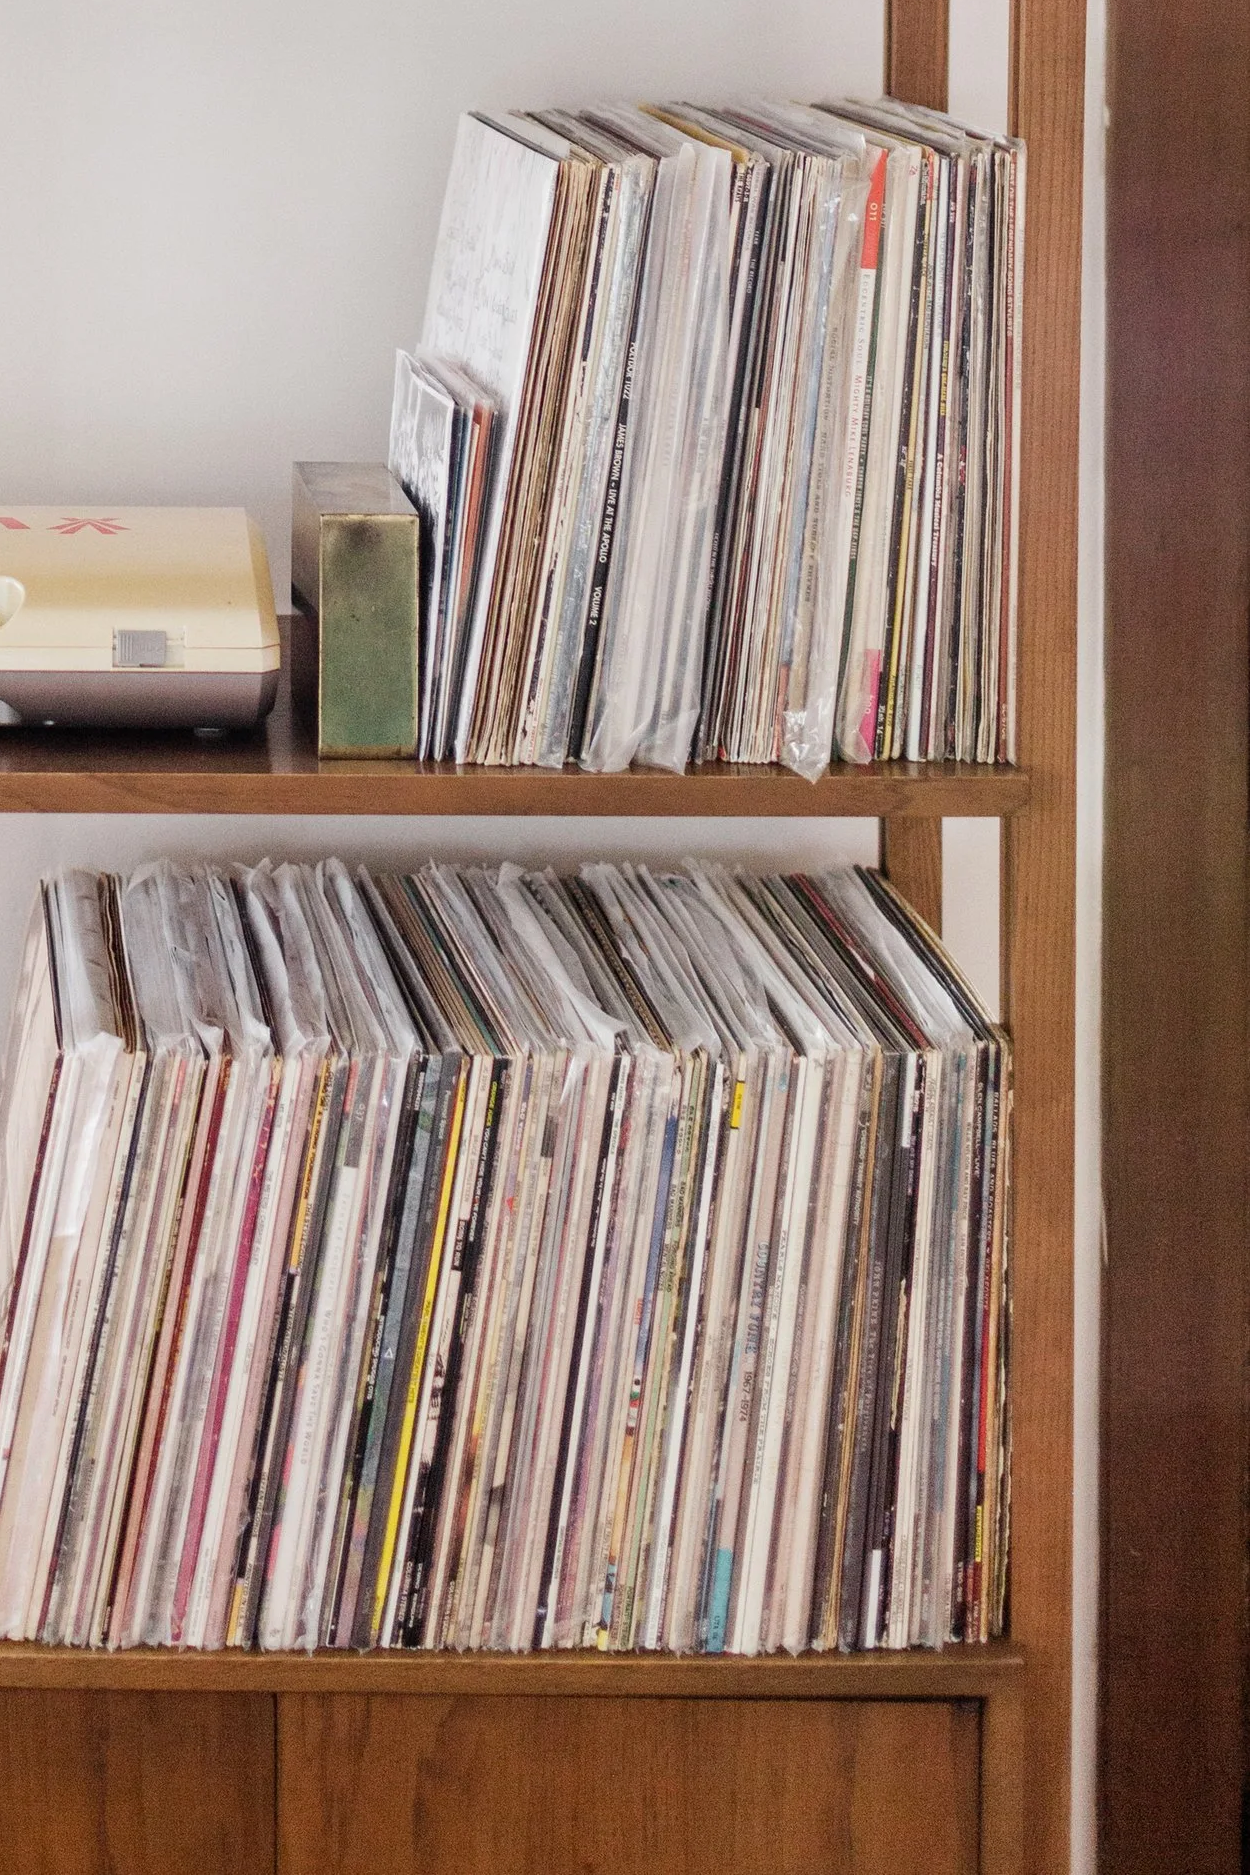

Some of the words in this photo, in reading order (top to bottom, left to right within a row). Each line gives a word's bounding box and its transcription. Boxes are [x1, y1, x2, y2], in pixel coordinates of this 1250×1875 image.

[746, 270, 755, 293] RECORD
[827, 326, 838, 361] SOCIAL
[822, 365, 834, 420] DISTORTION
[851, 374, 862, 412] MIGHTY
[613, 422, 626, 448] JAMES
[848, 417, 858, 441] MIKE
[609, 448, 622, 480] BROWN
[843, 445, 855, 497] LENABURG
[933, 461, 943, 499] Columbia
[604, 505, 615, 517] AT
[605, 488, 617, 505] LIVE
[813, 493, 821, 513] AND
[602, 516, 613, 532] THE
[932, 500, 940, 529] Musical
[598, 532, 611, 563] APOLLO
[930, 531, 939, 566] Treasury
[804, 564, 815, 602] RHYMES
[589, 585, 602, 617] VOLUME
[440, 1089, 451, 1118] Personal
[487, 1080, 498, 1108] ORANGE
[310, 1118, 321, 1149] STRONG
[437, 1118, 447, 1139] Space
[482, 1127, 491, 1141] YOU
[609, 1129, 617, 1155] SPECIALS
[469, 1134, 478, 1156] BRUCE
[480, 1141, 489, 1160] CAN'T
[963, 1144, 971, 1170] NELSON
[303, 1151, 316, 1199] FOUNDATION
[463, 1157, 475, 1202] SPRINGSTEEN
[477, 1160, 486, 1176] HIDE
[475, 1176, 484, 1195] YOUR
[678, 1180, 686, 1194] BAD
[674, 1195, 684, 1227] MANNERS
[852, 1189, 861, 1225] AUTHORITY
[455, 1220, 464, 1238] BORN
[468, 1211, 479, 1242] FOREVER
[452, 1251, 461, 1266] RUN
[454, 1241, 462, 1250] TO
[776, 1229, 786, 1271] PEARLS
[749, 1240, 769, 1308] COUNTRY
[871, 1260, 881, 1287] JOHN
[771, 1274, 782, 1320] MAHONE
[869, 1290, 879, 1325] PRINE
[319, 1309, 332, 1341] WHO'S
[744, 1312, 761, 1355] FUNK
[867, 1330, 876, 1349] The
[313, 1345, 326, 1380] GONNA
[410, 1351, 423, 1386] GREATEST
[765, 1337, 775, 1377] ECHOES
[865, 1352, 874, 1374] Tree
[308, 1383, 320, 1406] SAVE
[365, 1385, 374, 1400] OTIS
[407, 1387, 416, 1404] HITS
[737, 1370, 751, 1422] 1967-1974
[761, 1380, 770, 1410] FROM
[864, 1379, 873, 1389] of
[305, 1411, 316, 1427] THE
[758, 1413, 767, 1436] THE
[860, 1393, 872, 1452] Forgiveness
[299, 1431, 313, 1465] WORLD
[753, 1438, 764, 1485] PRAIRIE
[251, 1502, 262, 1538] RECORDS
[242, 1562, 253, 1595] PRINTED
[401, 1560, 413, 1596] COLUMBIA
[240, 1596, 248, 1606] IN
[397, 1595, 408, 1622] STEREO
[623, 1585, 634, 1618] PORTRAIT
[619, 1621, 629, 1647] STEREO
